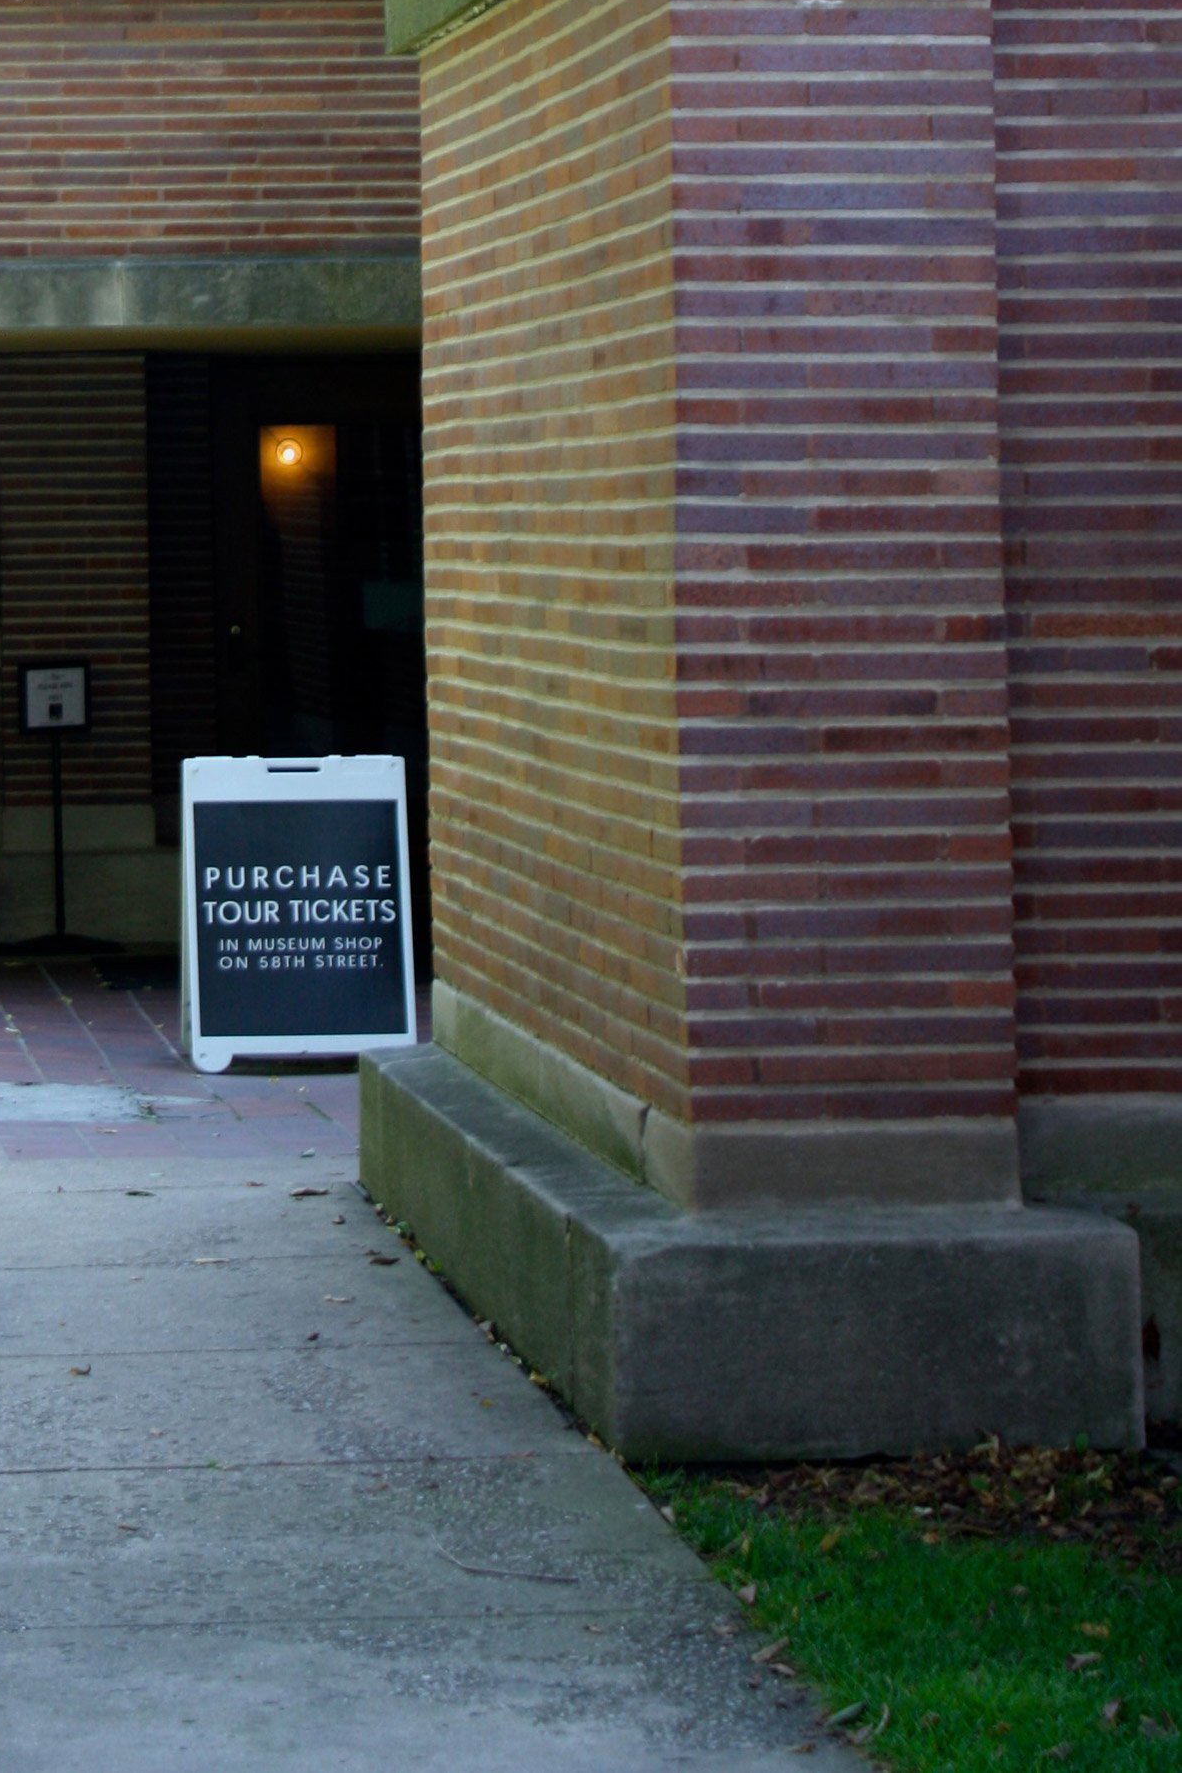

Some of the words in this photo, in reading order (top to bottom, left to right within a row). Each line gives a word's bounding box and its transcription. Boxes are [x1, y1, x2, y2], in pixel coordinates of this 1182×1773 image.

[205, 865, 392, 890] PURCHASE
[203, 900, 280, 924] TOUR
[288, 899, 396, 923] TICKETS
[220, 939, 239, 951] IN
[248, 937, 326, 951] MUSEUM
[334, 936, 383, 950] SHOP
[219, 956, 248, 970] ON
[259, 955, 306, 969] 58TH
[315, 954, 384, 968] STREET.
